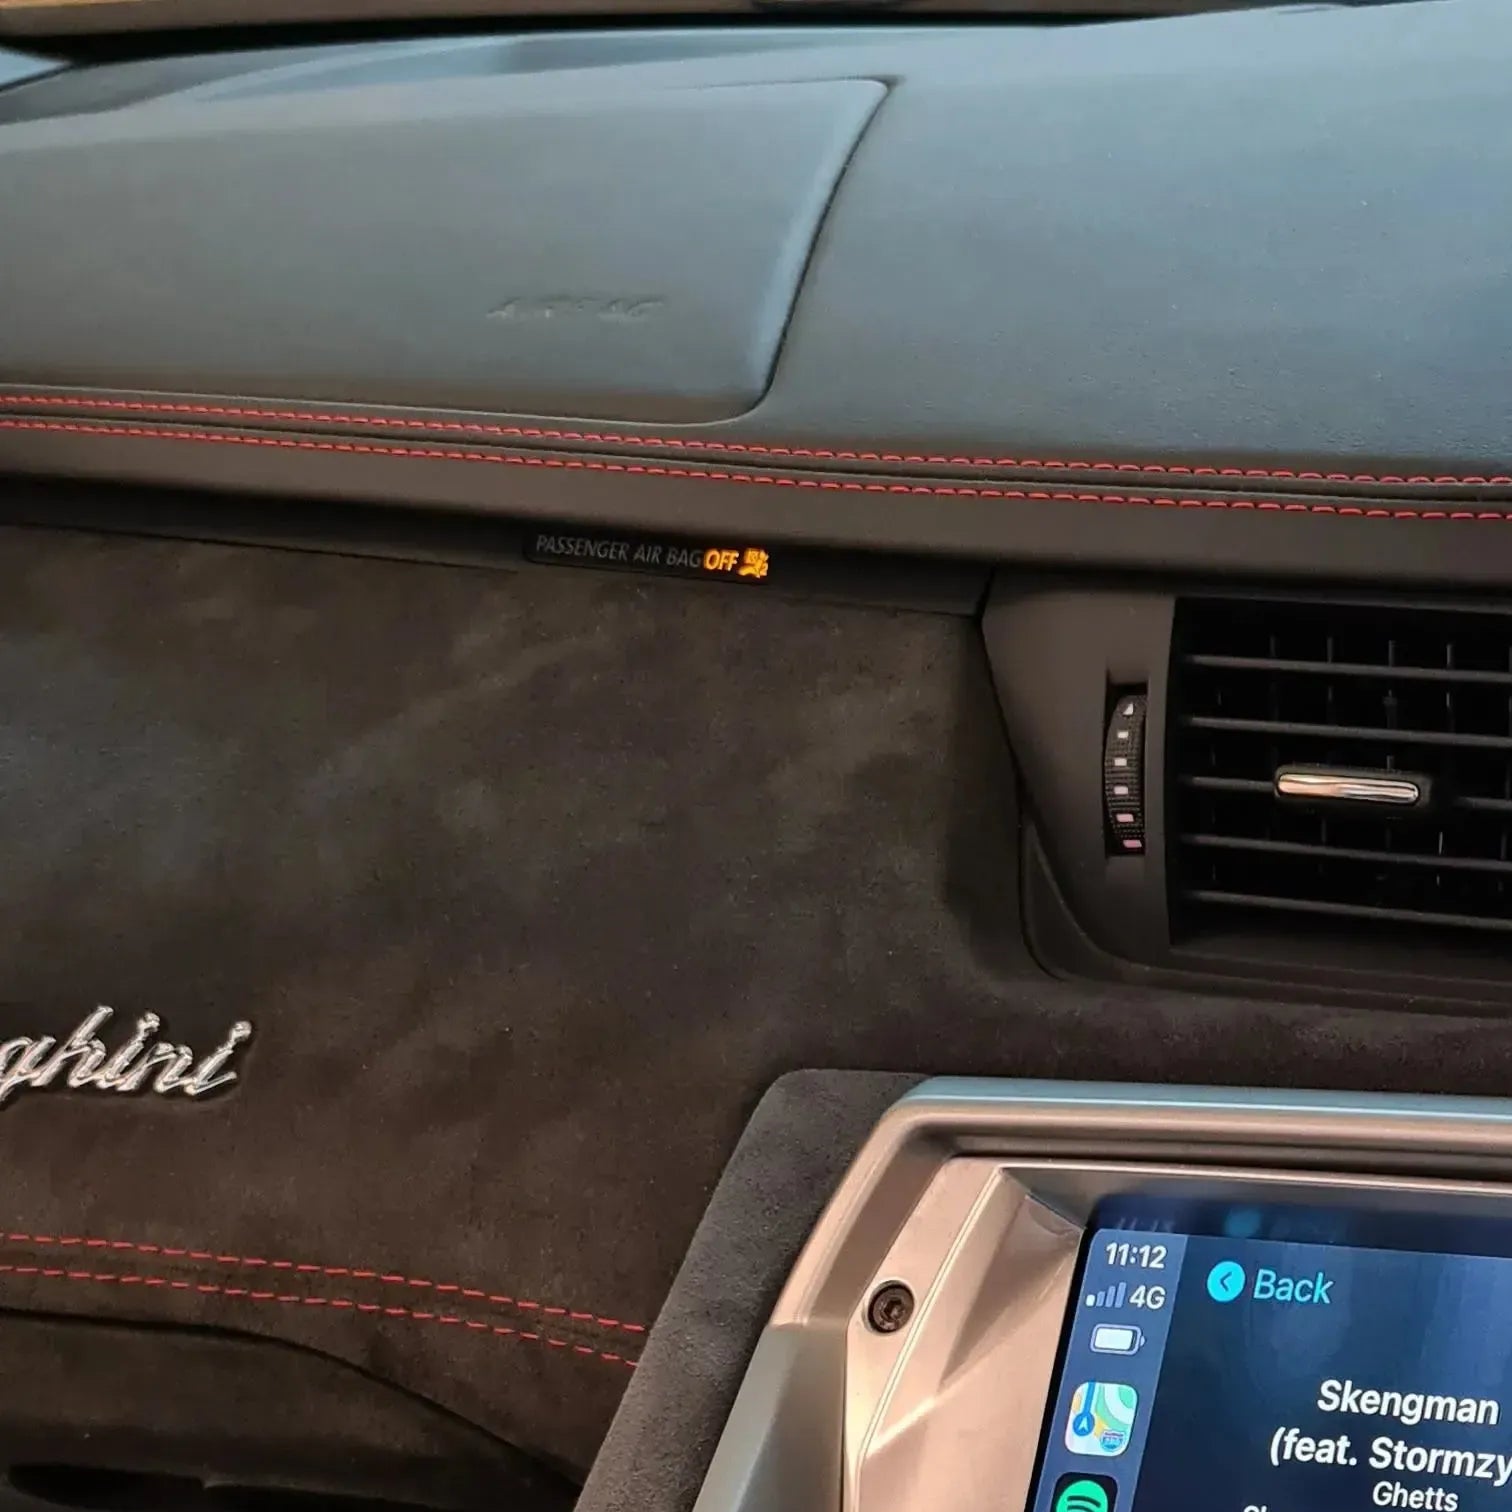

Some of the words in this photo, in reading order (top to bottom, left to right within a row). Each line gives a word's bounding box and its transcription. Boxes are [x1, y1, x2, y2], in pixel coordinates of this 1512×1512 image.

[536, 534, 628, 561] PASSENGER
[633, 543, 661, 565] AIR
[666, 549, 700, 568] BAG
[704, 549, 739, 571] OFF
[1105, 1241, 1168, 1269] 11:12
[1129, 1284, 1167, 1310] 4G
[1253, 1268, 1334, 1305] Back
[1316, 1378, 1500, 1426] Skengman
[1270, 1426, 1358, 1467] (feat.
[1372, 1481, 1459, 1512] Ghetts
